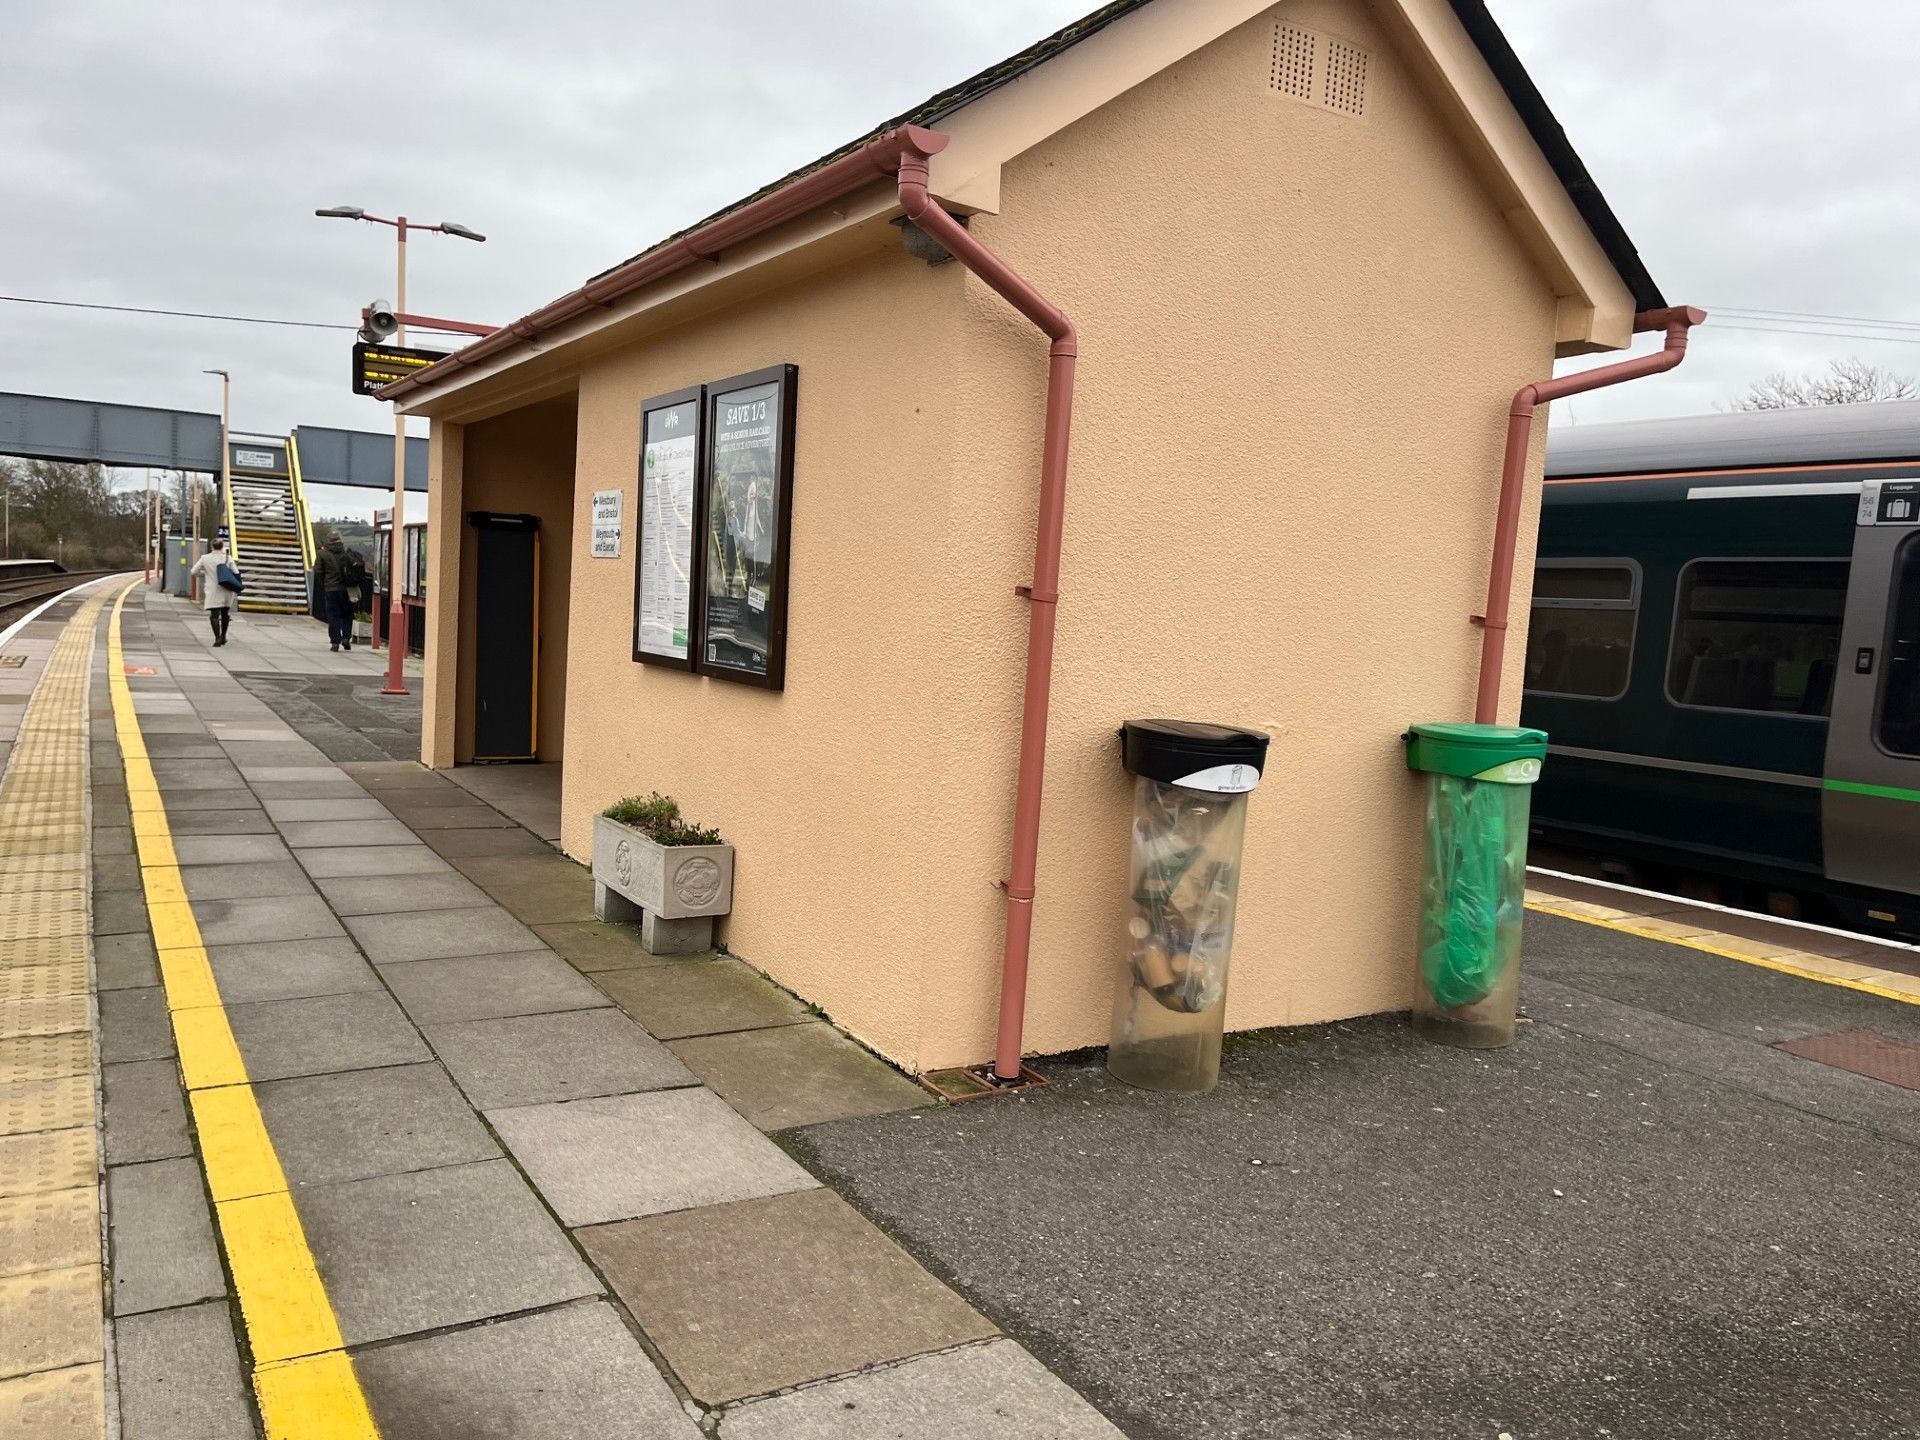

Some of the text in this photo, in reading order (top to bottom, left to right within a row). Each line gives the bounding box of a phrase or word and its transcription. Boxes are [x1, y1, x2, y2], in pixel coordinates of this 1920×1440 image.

[726, 401, 766, 425] SAVE 1/3
[749, 426, 771, 437] RAILCARD
